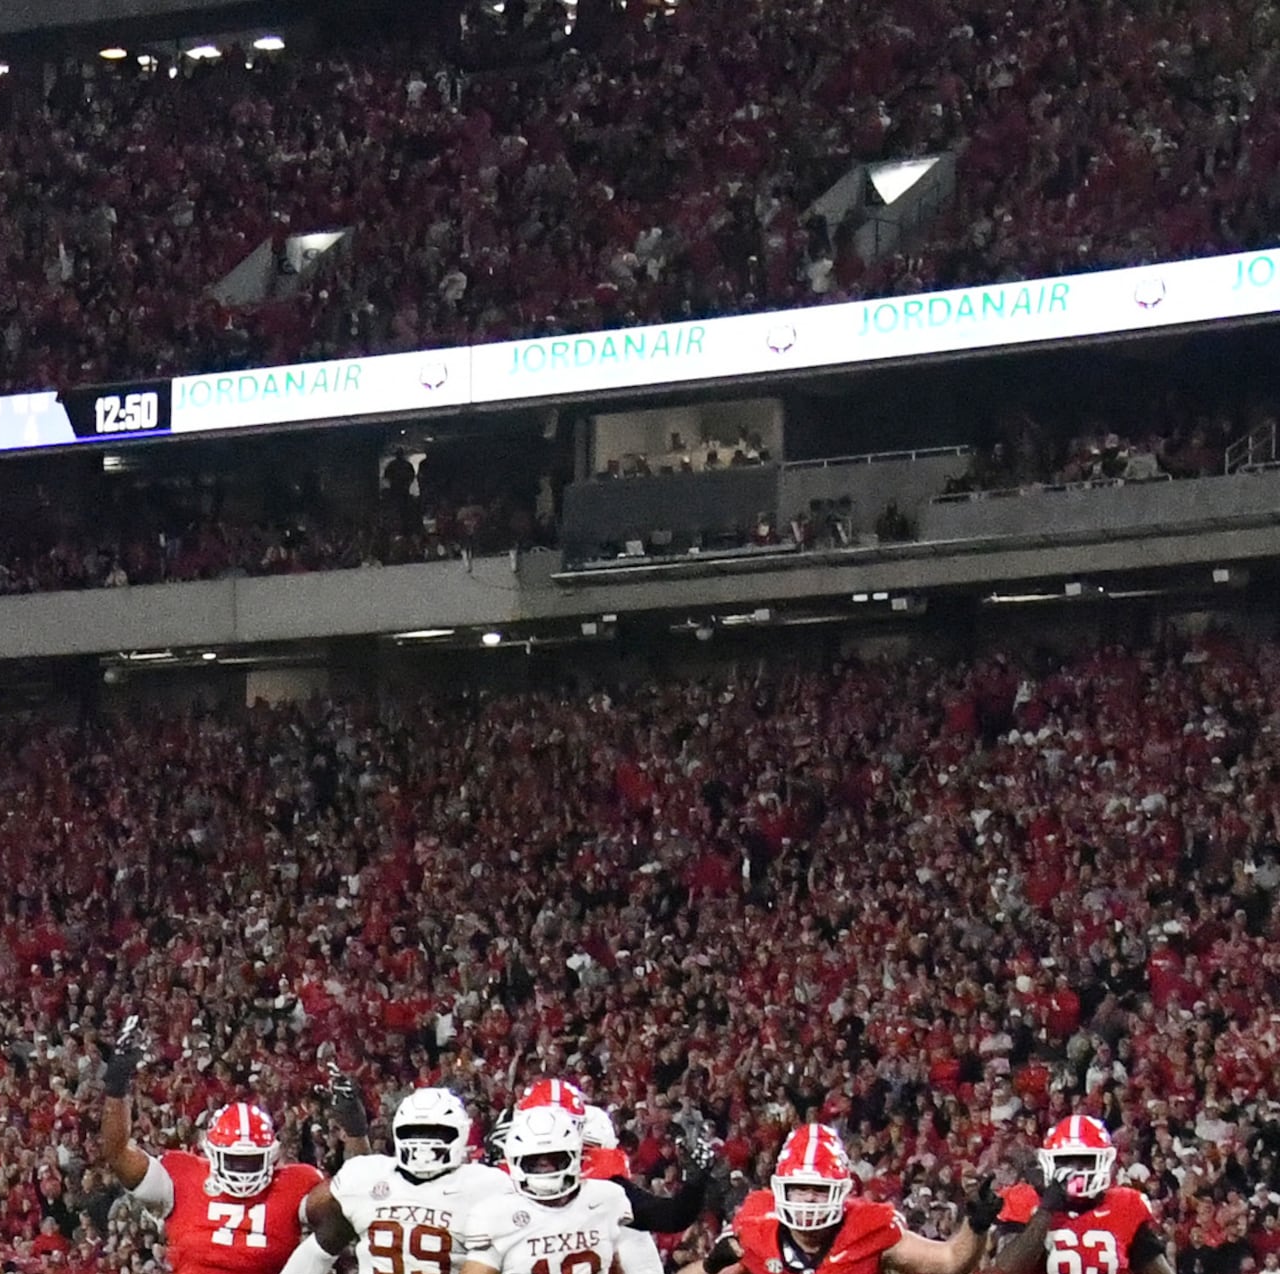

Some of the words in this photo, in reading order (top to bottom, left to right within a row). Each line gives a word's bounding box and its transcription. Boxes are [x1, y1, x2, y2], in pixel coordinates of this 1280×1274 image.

[95, 392, 158, 433] 12:50
[207, 1201, 267, 1248] 71
[375, 1205, 453, 1229] TEXAS
[527, 1229, 600, 1257] TEXAS
